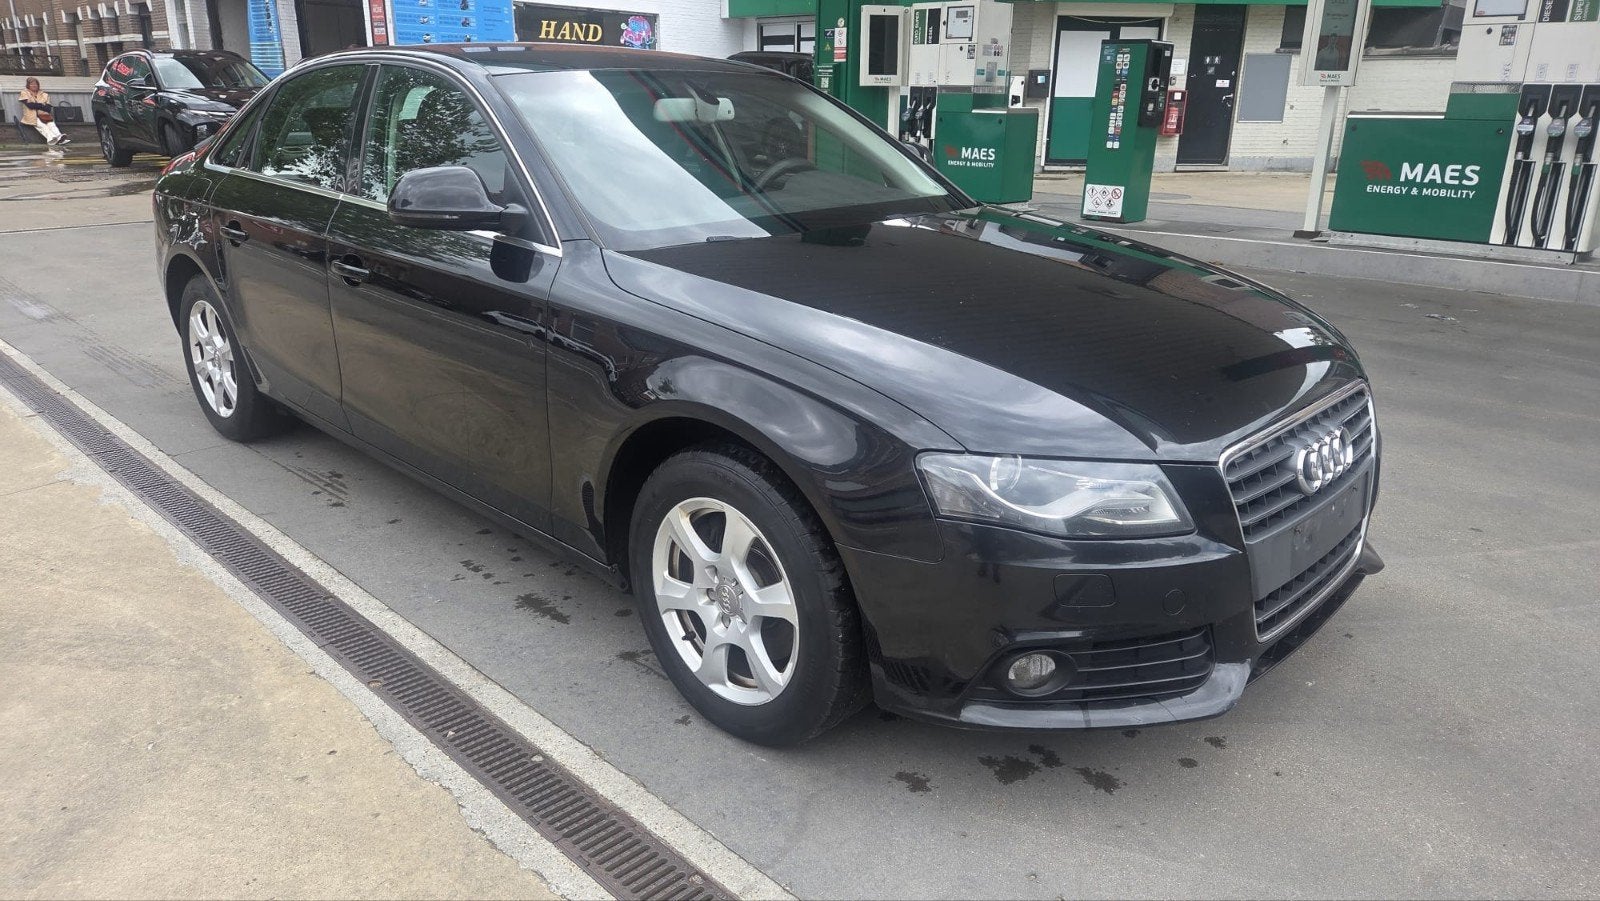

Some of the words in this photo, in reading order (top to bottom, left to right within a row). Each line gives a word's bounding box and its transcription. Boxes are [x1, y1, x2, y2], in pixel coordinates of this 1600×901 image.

[538, 20, 603, 42] HAND
[961, 146, 996, 161] MAES
[1399, 162, 1481, 186] MAES
[1366, 184, 1409, 195] ENERGY
[1410, 187, 1419, 196] &
[1422, 187, 1476, 199] MOBILITY
